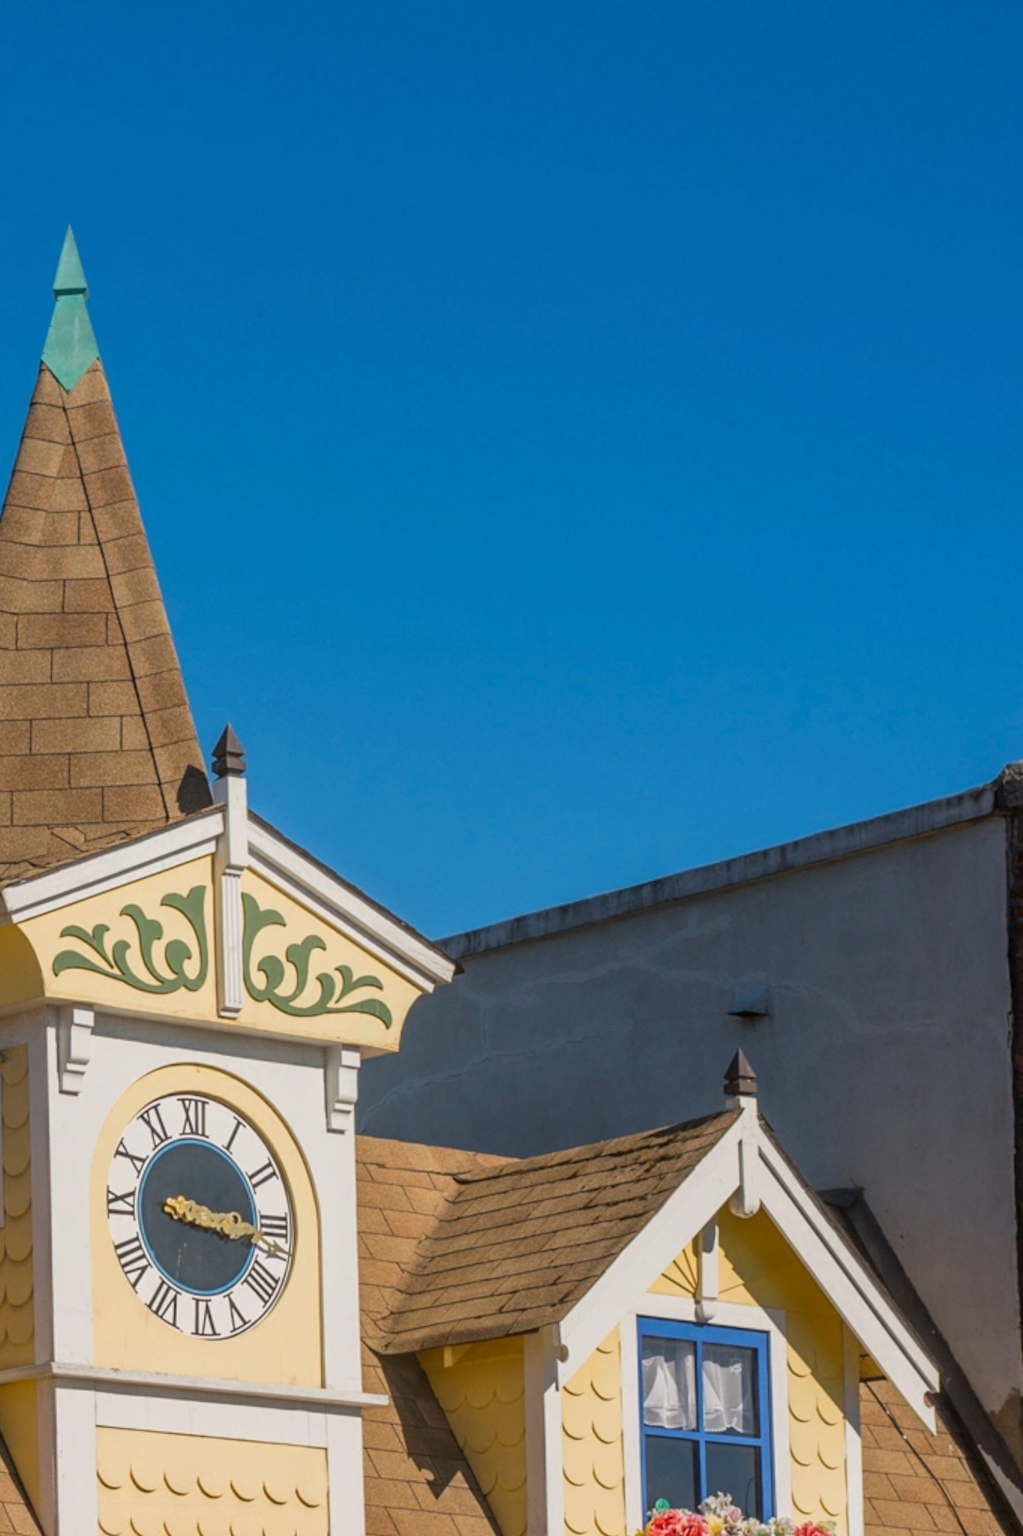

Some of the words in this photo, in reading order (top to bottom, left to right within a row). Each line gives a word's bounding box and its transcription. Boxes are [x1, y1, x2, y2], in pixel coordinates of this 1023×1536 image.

[137, 1103, 172, 1151] XI
[177, 1098, 210, 1138] XII
[222, 1116, 246, 1155] I
[114, 1137, 149, 1178] X
[245, 1157, 279, 1194] II
[106, 1185, 137, 1221] IX
[112, 1232, 152, 1294] VIII
[145, 1276, 183, 1333] VII
[191, 1297, 221, 1336] VI
[223, 1291, 251, 1333] V
